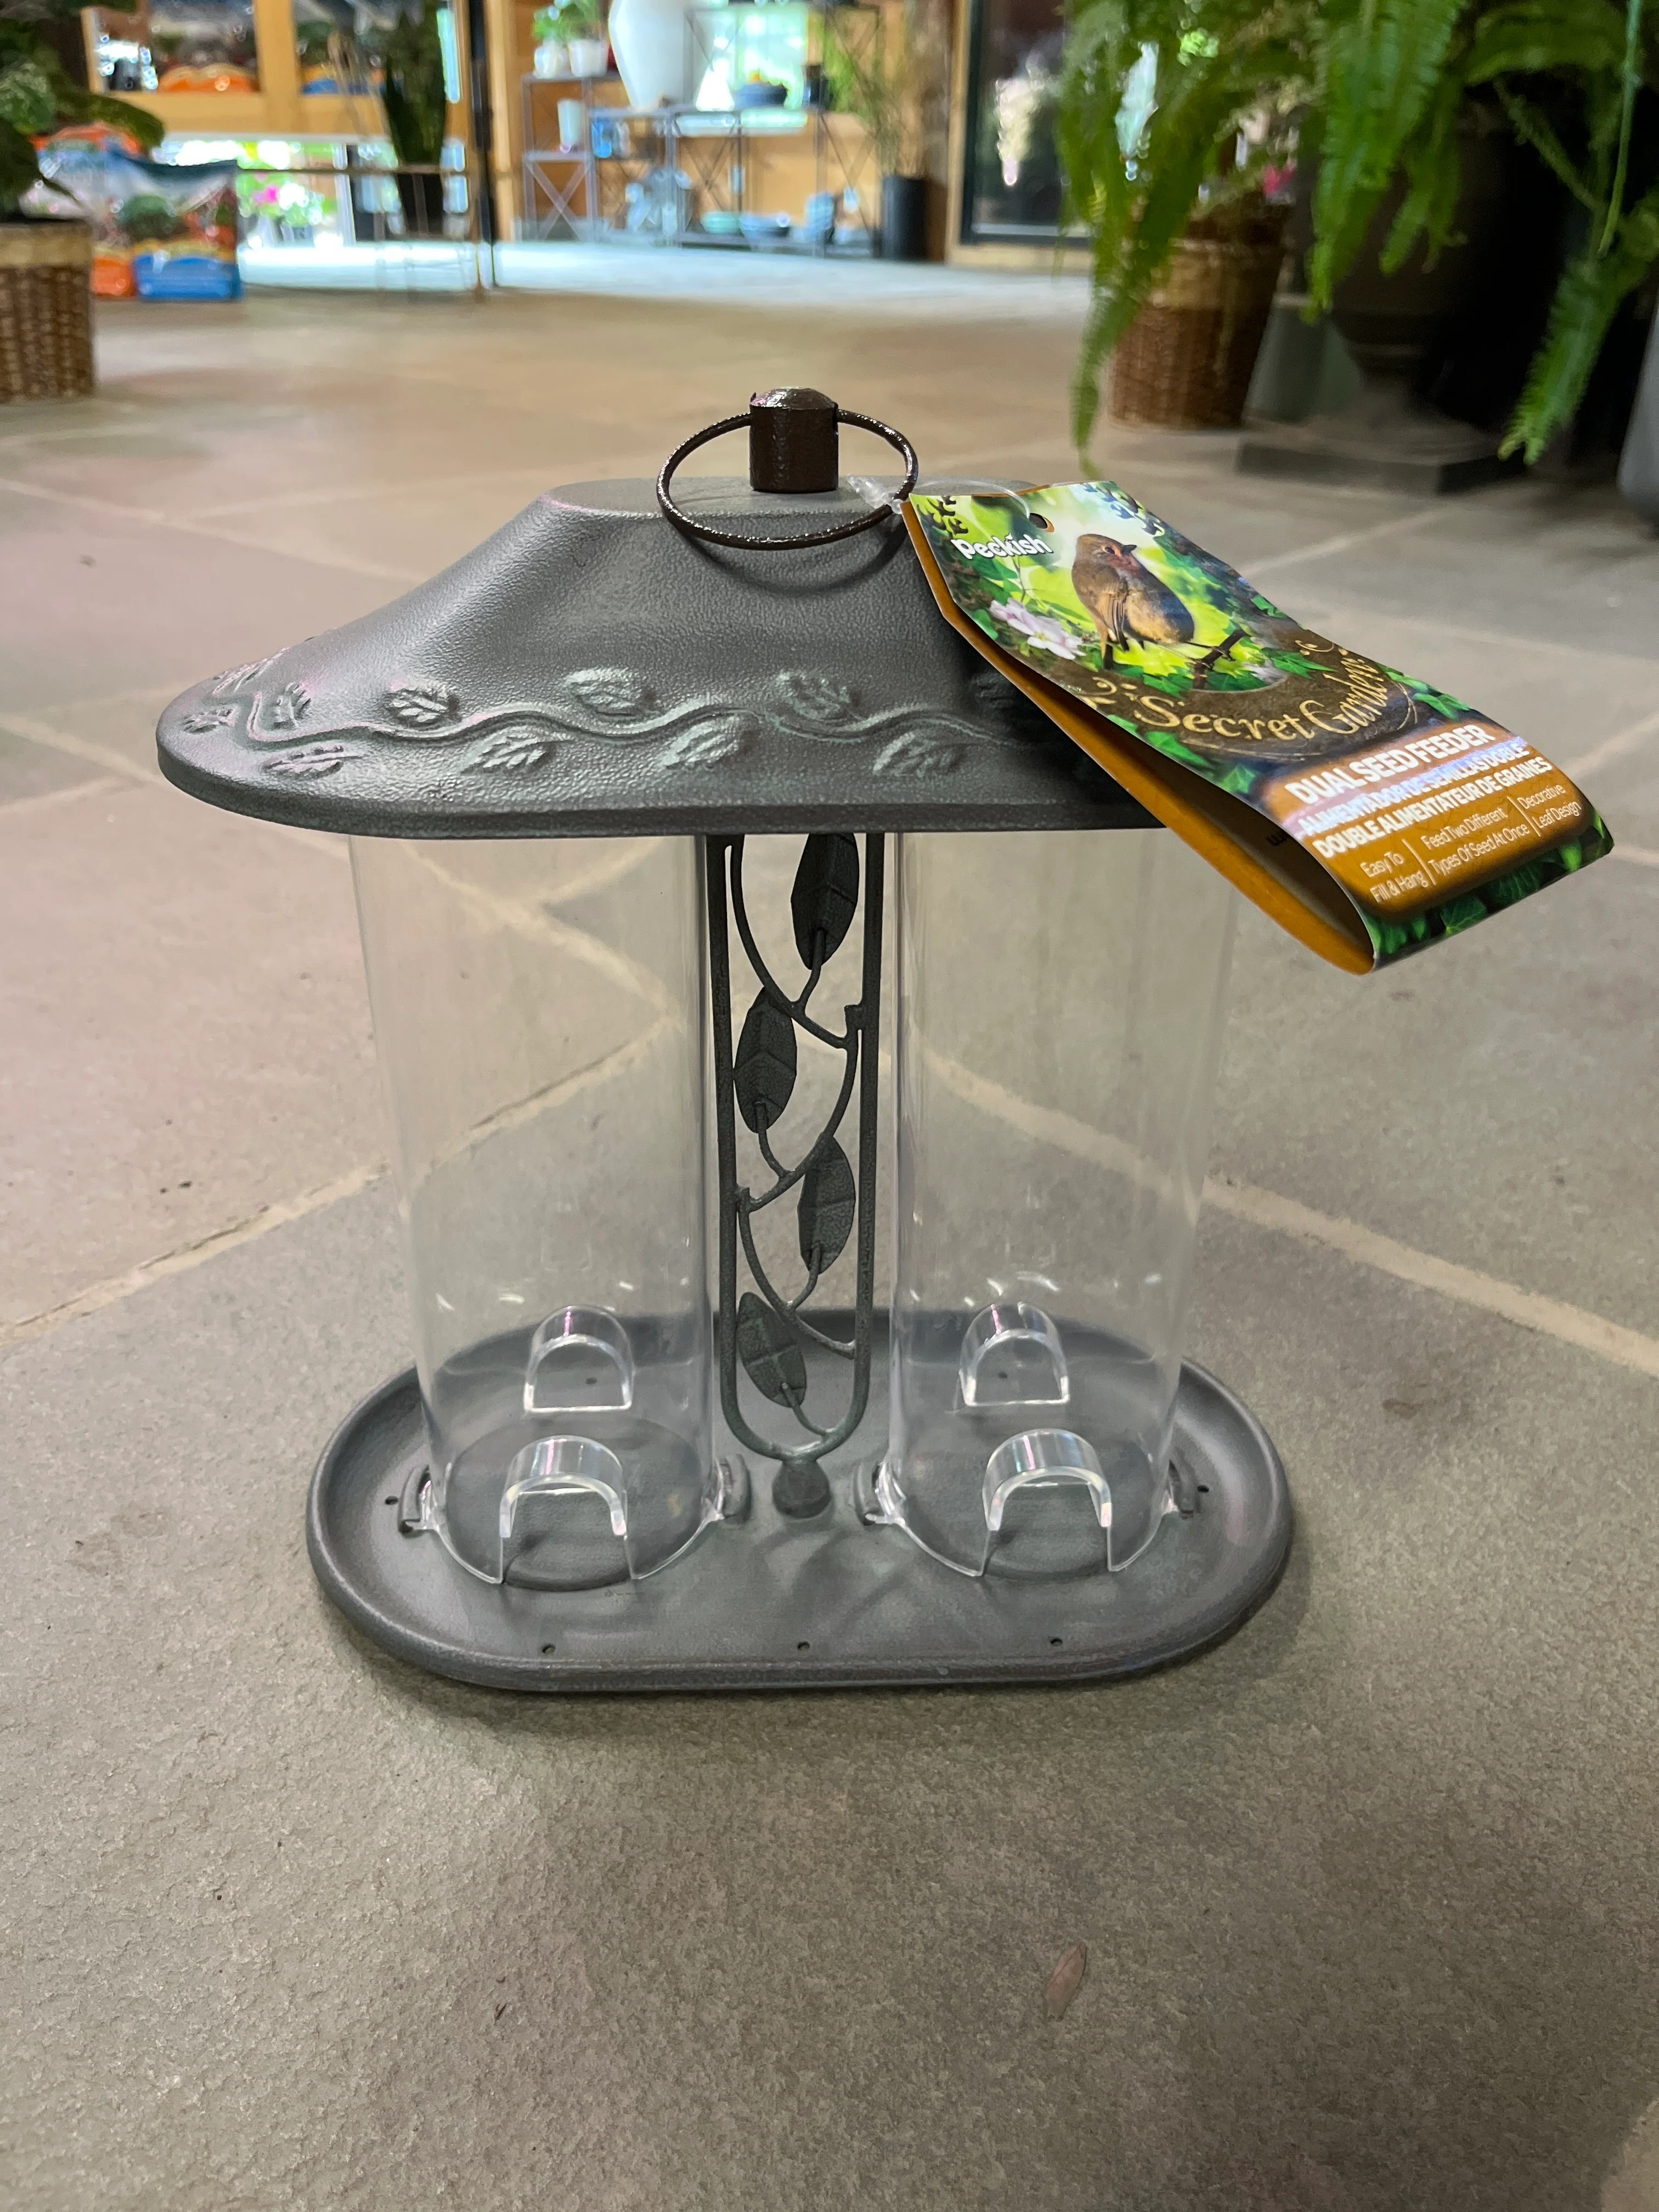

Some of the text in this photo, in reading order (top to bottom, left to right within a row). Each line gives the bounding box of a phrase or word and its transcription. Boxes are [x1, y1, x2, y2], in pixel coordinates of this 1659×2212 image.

[951, 534, 1053, 560] Peckish
[1134, 658, 1388, 740] Secret Garden
[1284, 725, 1496, 804] DUAL SEED FEEDER
[1298, 742, 1530, 836] ALIMENTADOR DE SEMILLAS DOBLE
[1312, 820, 1386, 859] DOUBLE
[1377, 783, 1485, 833] ALIMENTATEUR
[1475, 776, 1503, 794] DE
[1494, 757, 1553, 787] GRAINES
[1517, 785, 1566, 809] Decorative
[1420, 807, 1508, 850] Feed Two Different
[1532, 802, 1582, 828] Leaf Design
[1360, 851, 1404, 878] Easy To
[1427, 824, 1530, 876] Types Of Seed At Once
[1369, 870, 1429, 904] Fill & Hang
